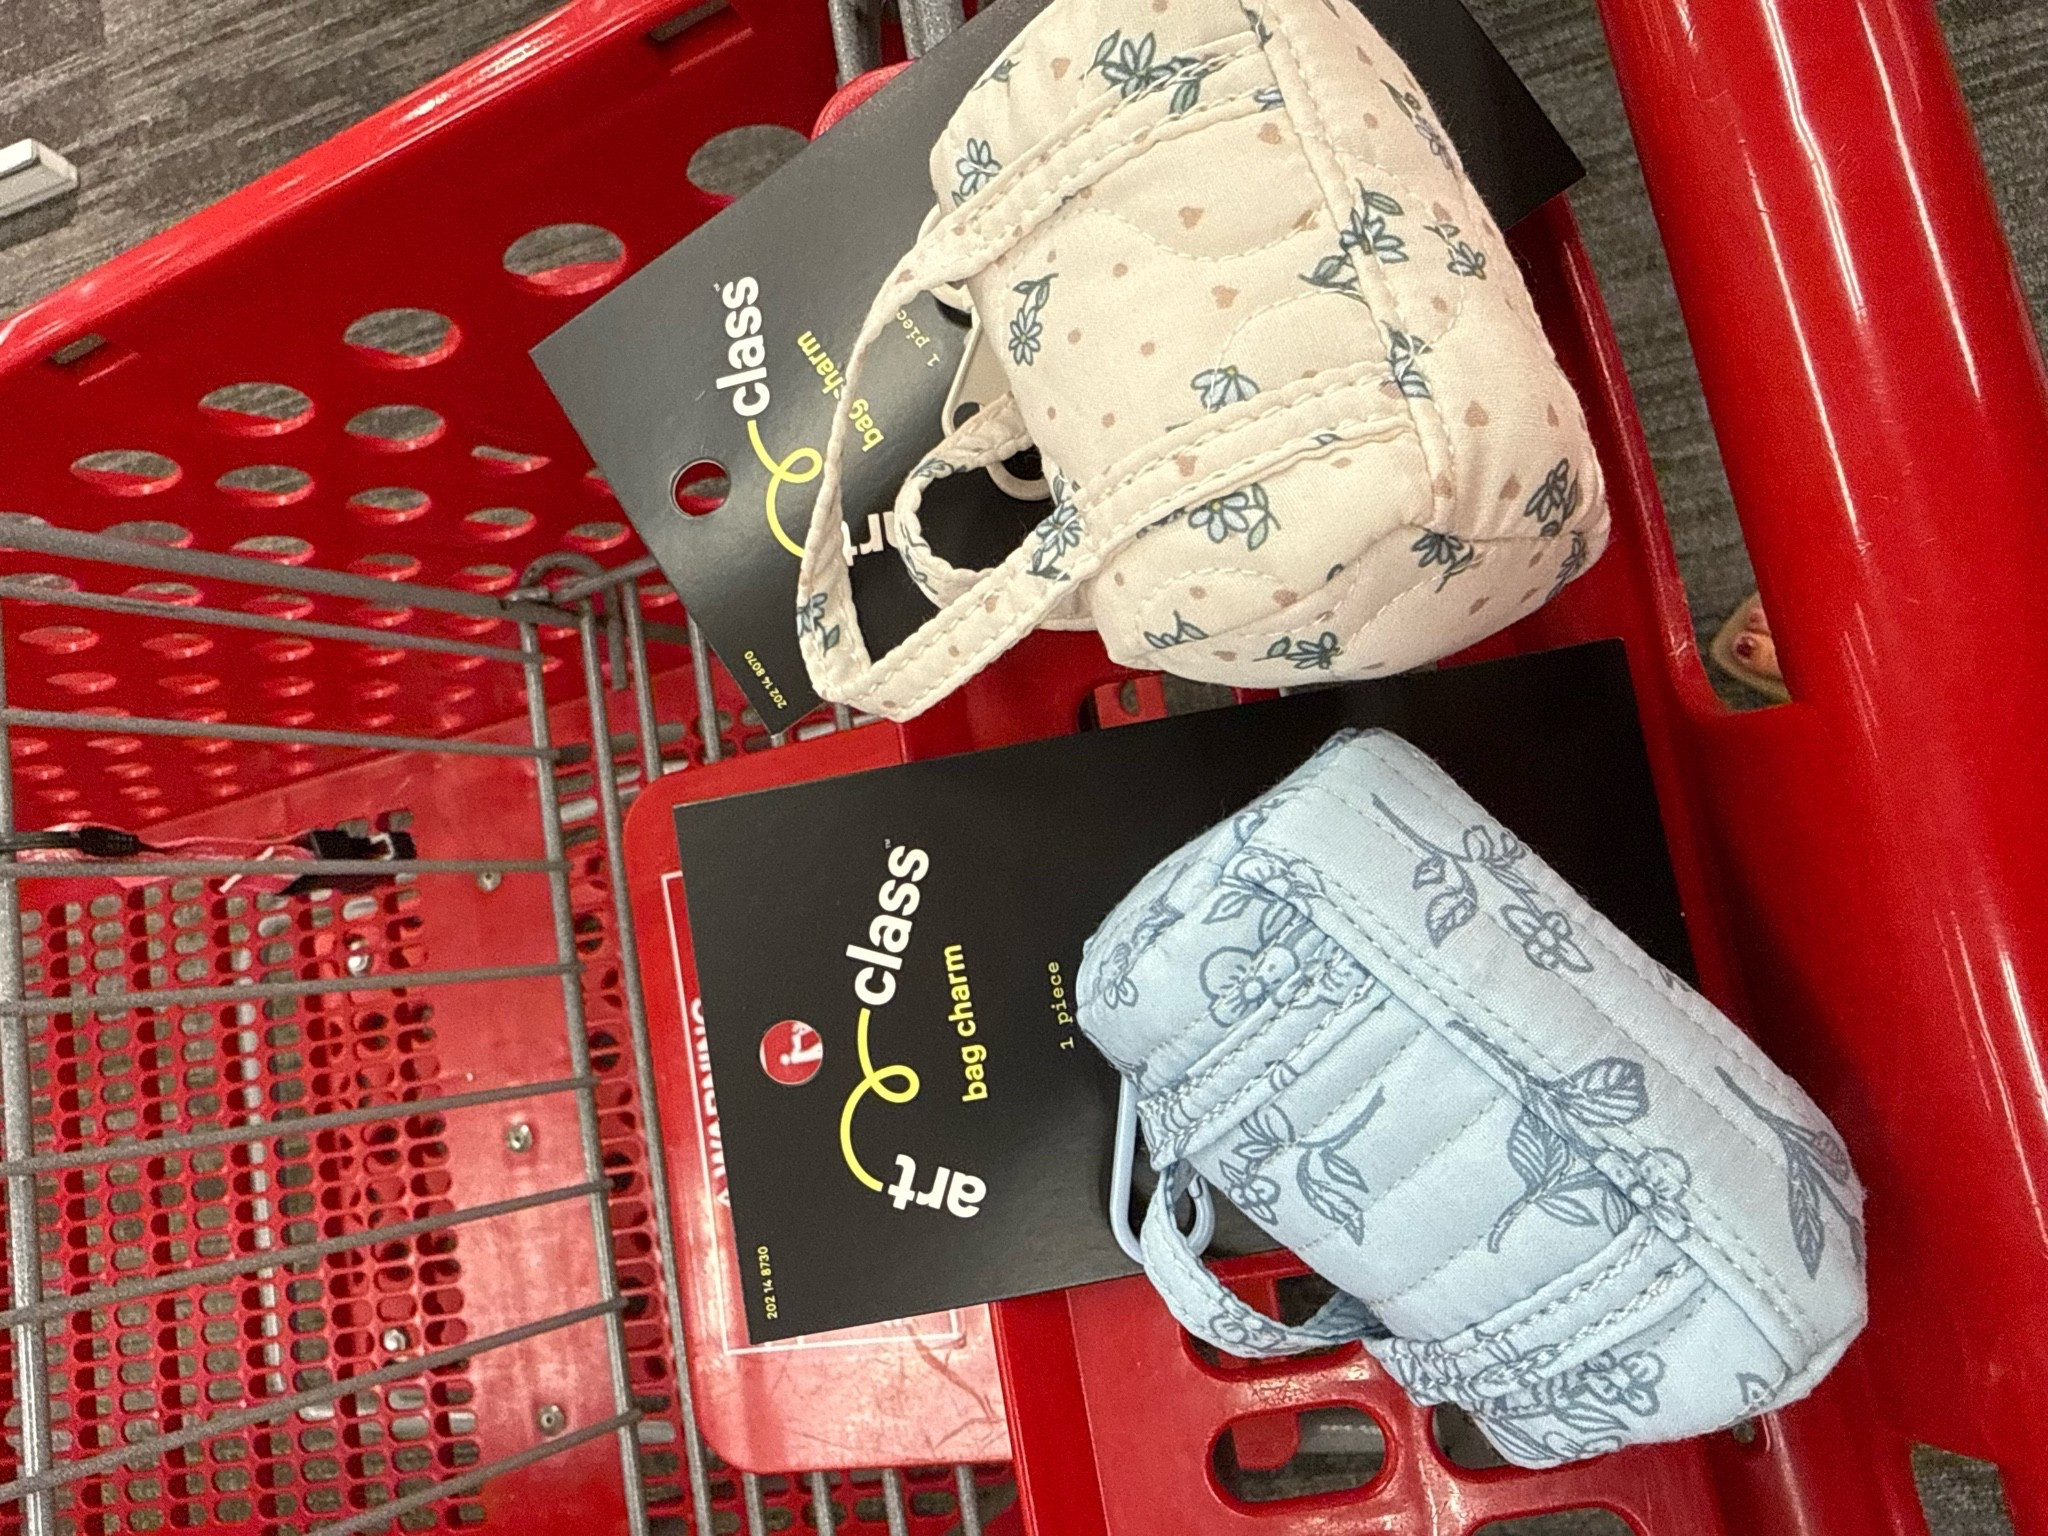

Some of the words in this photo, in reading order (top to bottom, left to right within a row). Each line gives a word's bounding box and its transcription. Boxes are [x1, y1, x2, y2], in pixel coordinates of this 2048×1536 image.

[715, 276, 771, 417] class
[896, 309, 931, 349] piec
[797, 330, 844, 400] harm
[926, 353, 941, 367] 1
[848, 398, 885, 453] bag
[744, 650, 766, 677] 8070
[761, 676, 774, 690] 14
[769, 687, 788, 709] 202
[845, 845, 930, 1006] class
[944, 944, 977, 1038] charm
[1048, 961, 1074, 1025] piece
[1059, 1037, 1075, 1050] 1
[962, 1044, 988, 1103] bag
[887, 1153, 987, 1219] art
[757, 1245, 772, 1277] 8730
[762, 1279, 774, 1293] 14
[766, 1295, 778, 1320] 202
